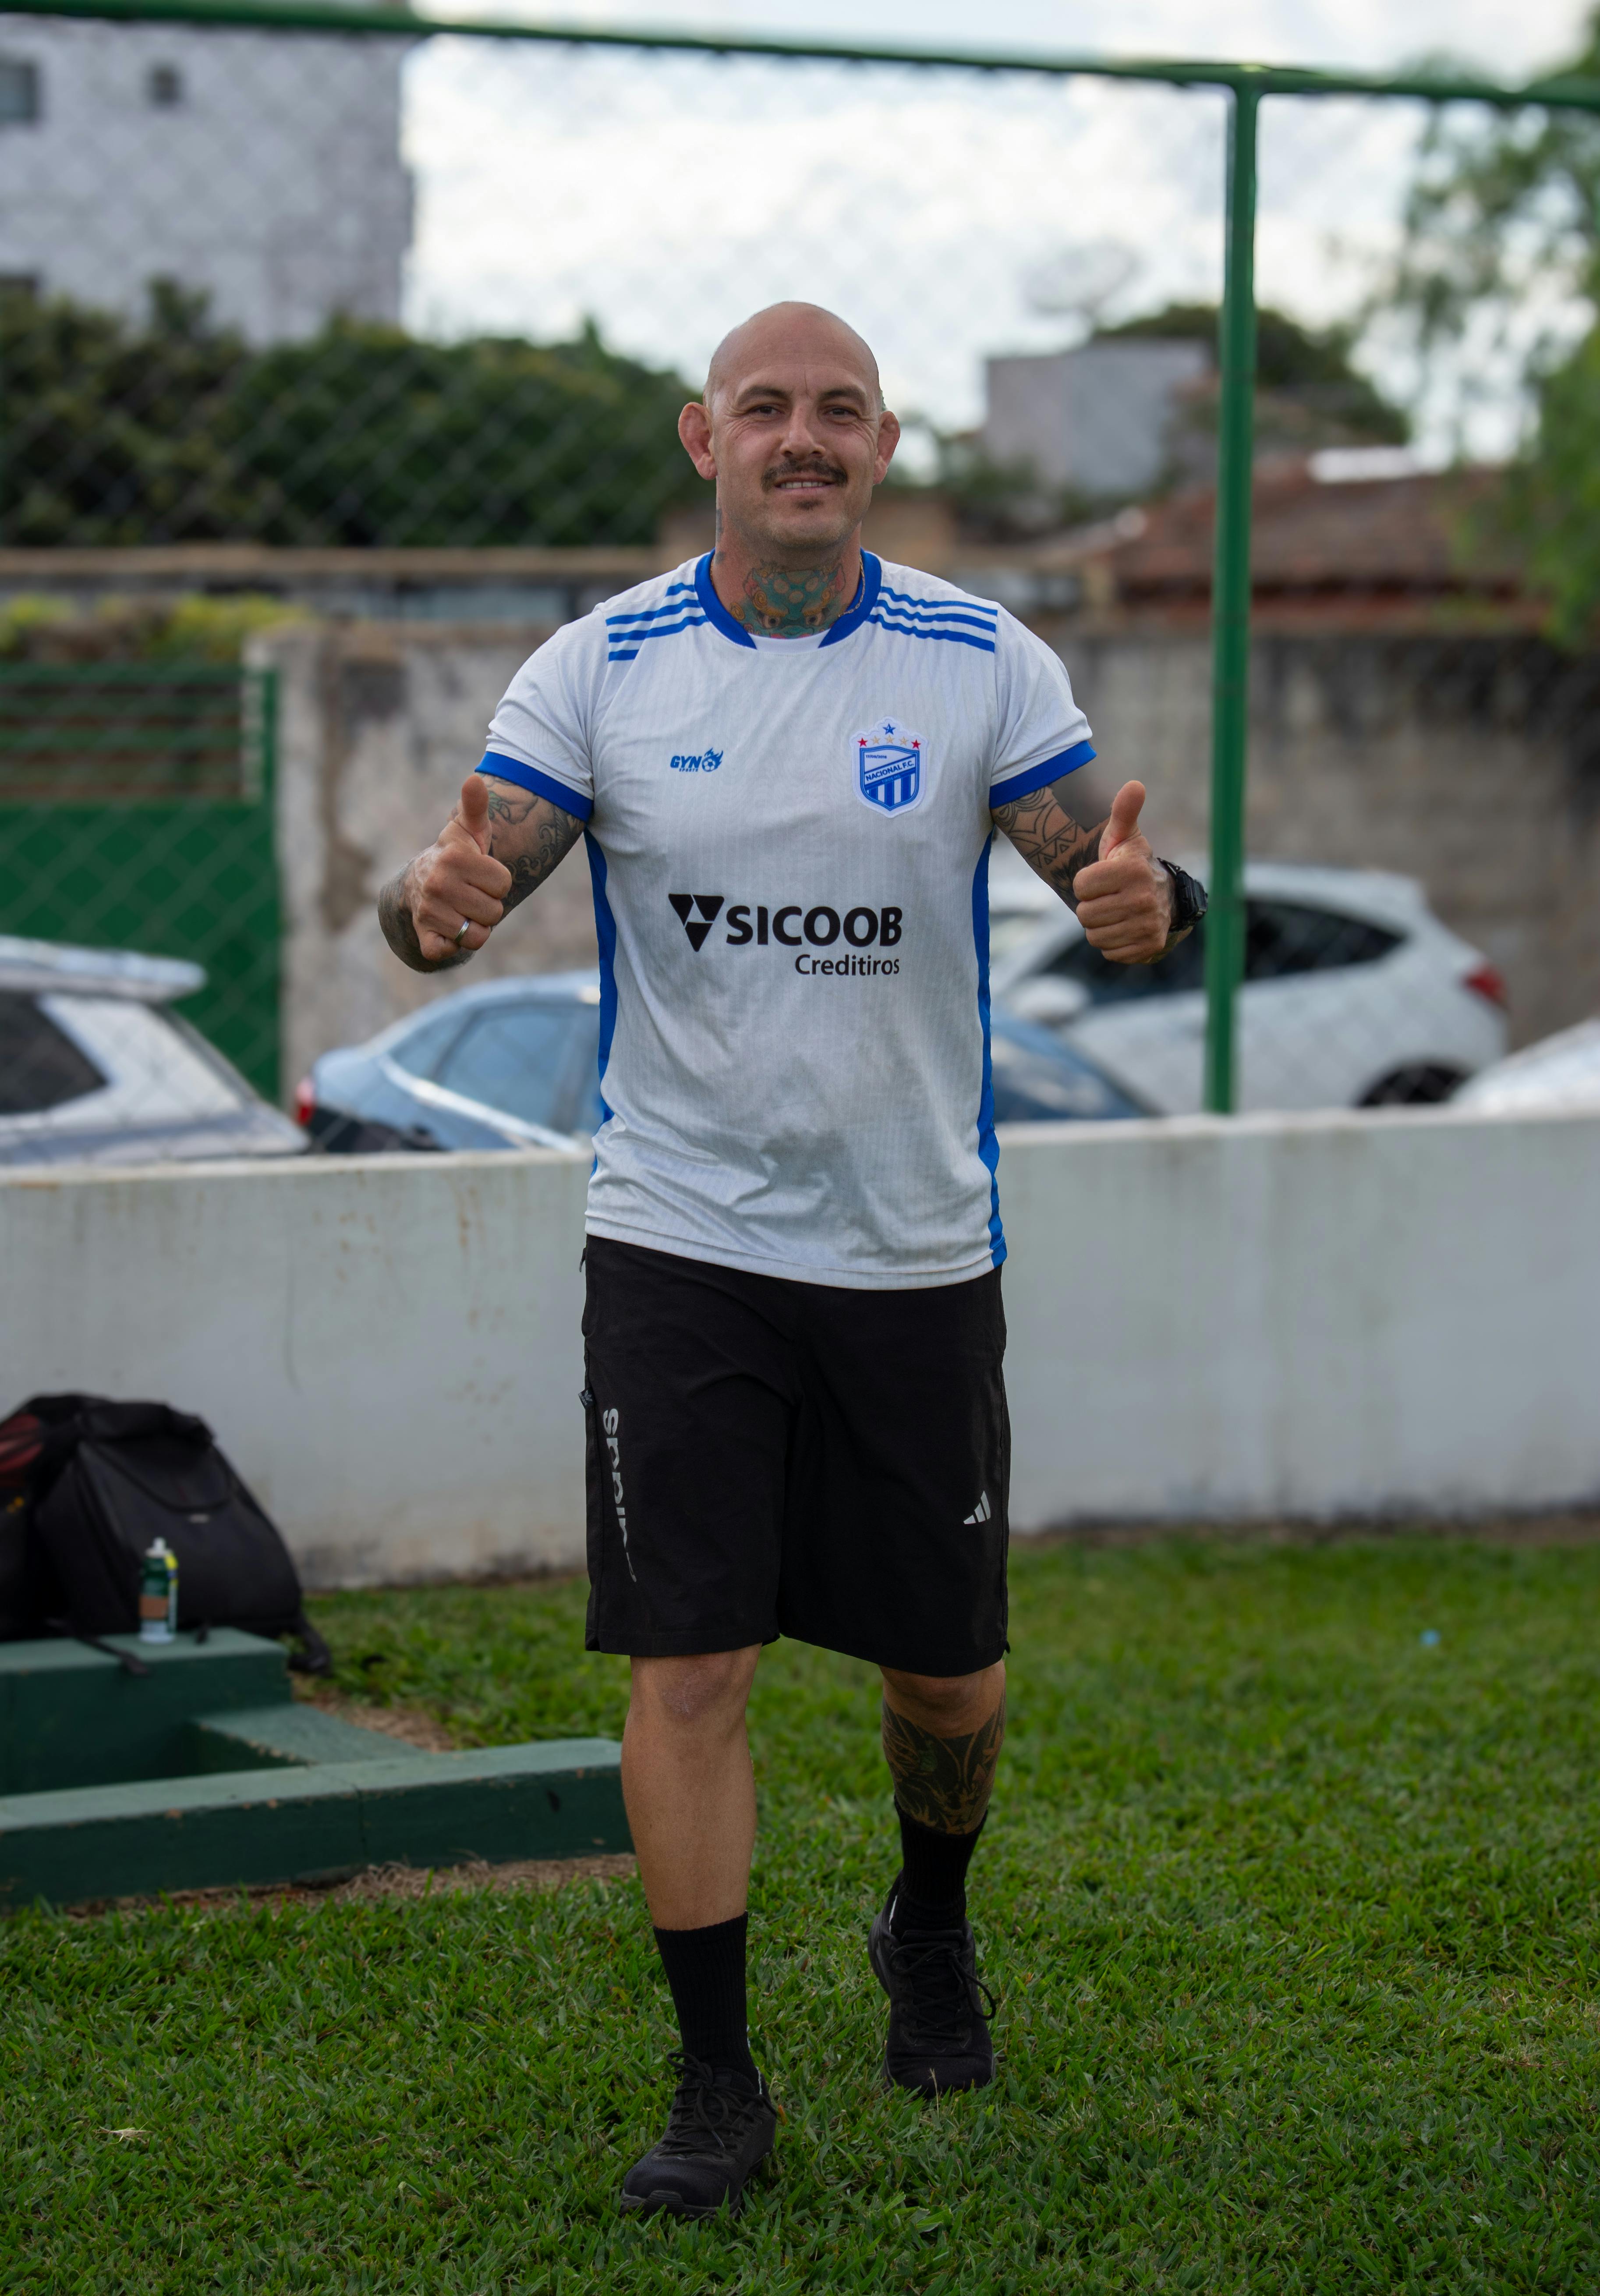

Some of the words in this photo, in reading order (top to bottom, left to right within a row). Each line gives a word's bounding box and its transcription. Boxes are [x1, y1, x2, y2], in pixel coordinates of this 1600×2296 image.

[865, 764, 903, 781] NACIONAL
[903, 760, 914, 769] F.C.
[726, 905, 903, 948] SICOOB
[795, 954, 899, 976] Creditiros
